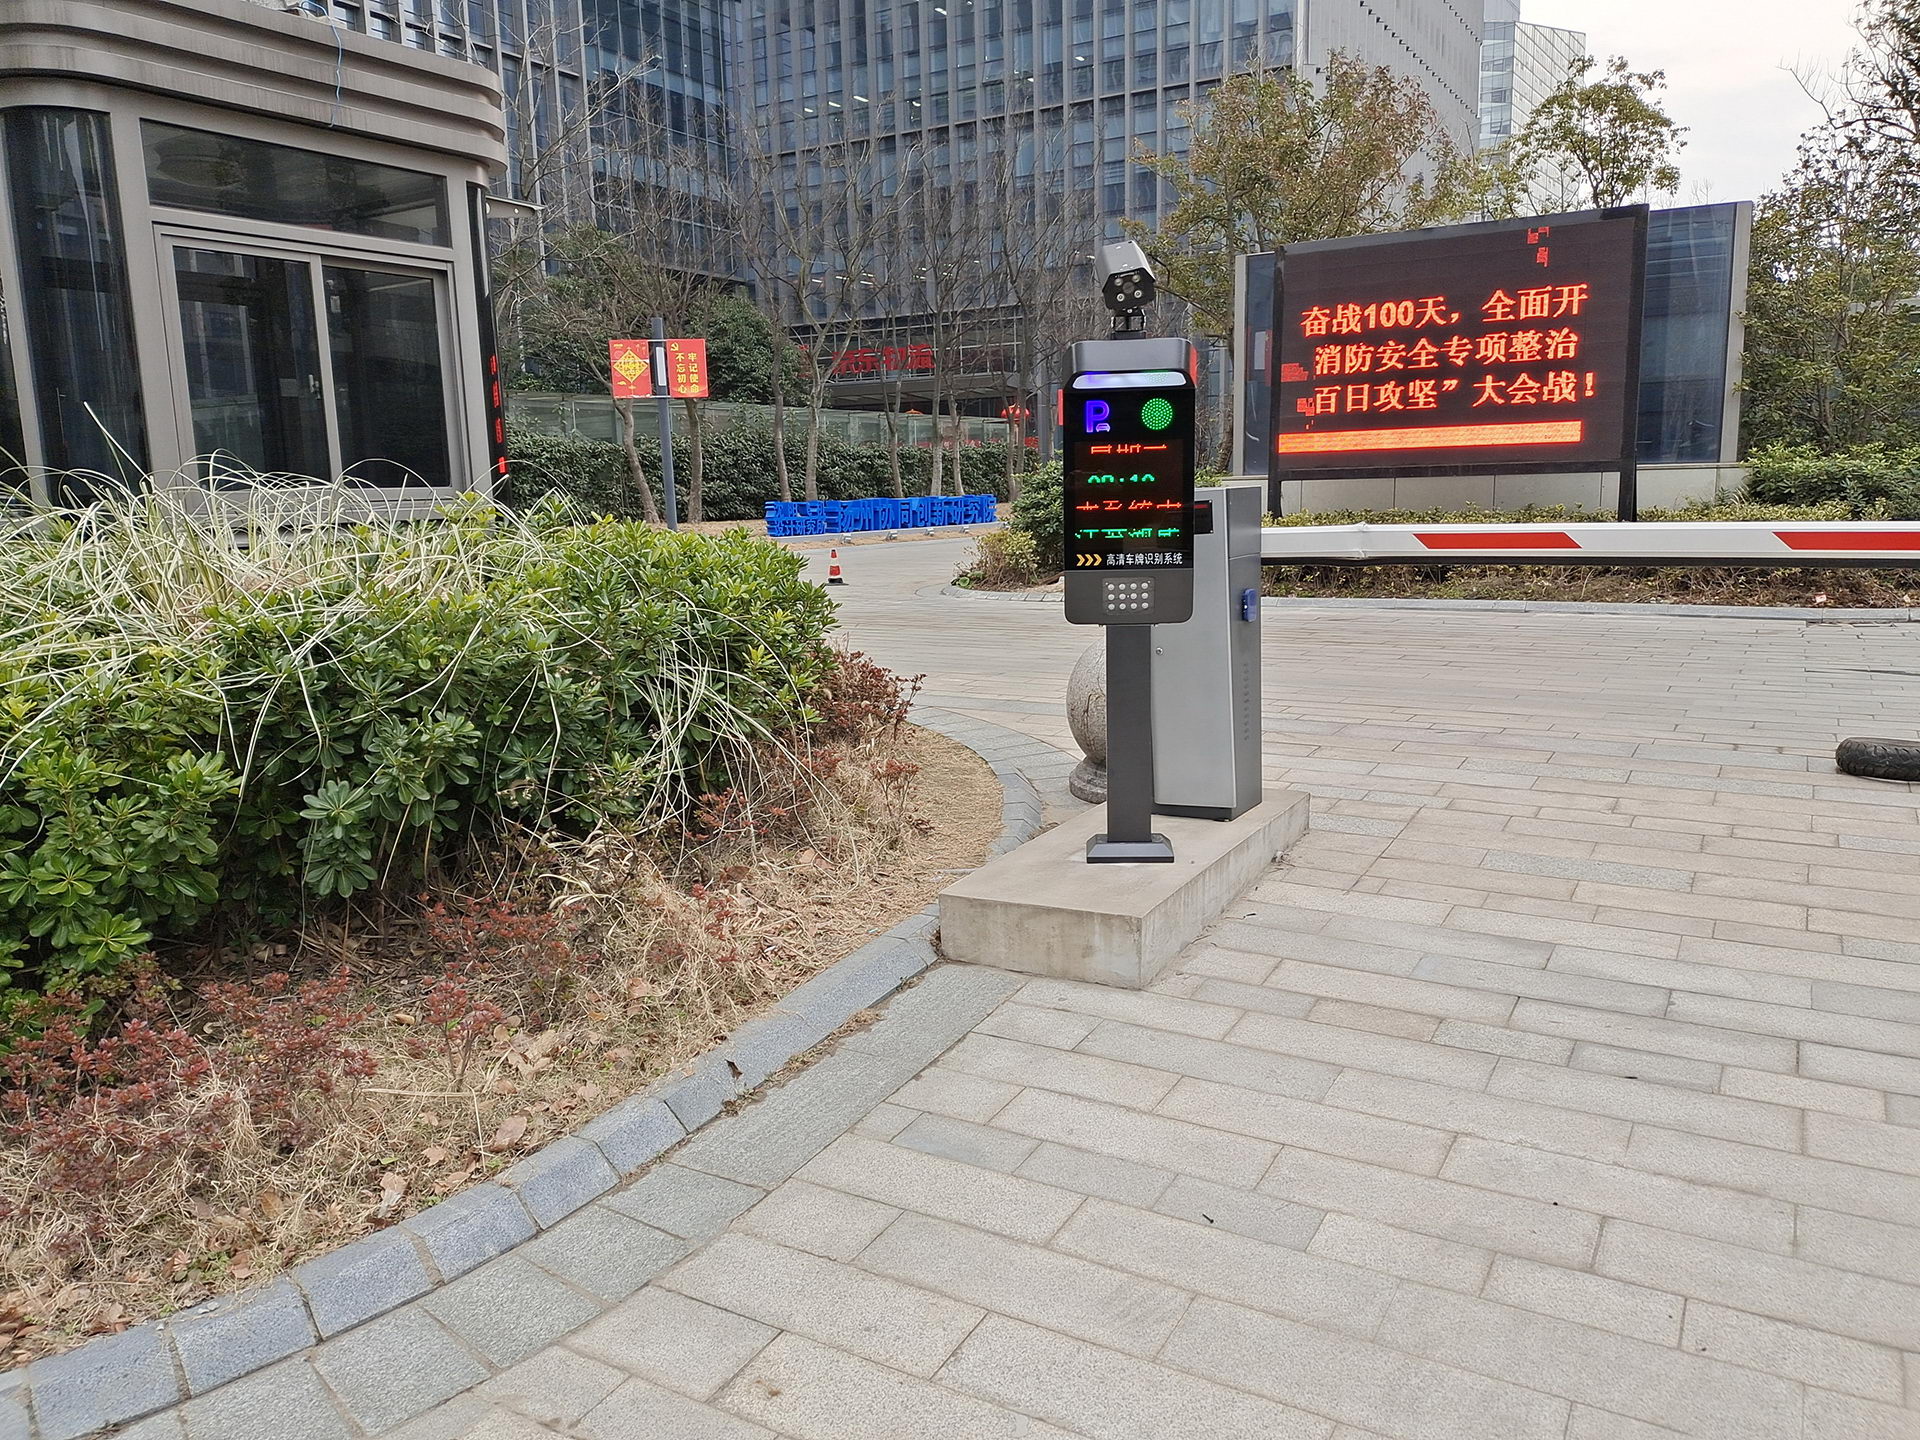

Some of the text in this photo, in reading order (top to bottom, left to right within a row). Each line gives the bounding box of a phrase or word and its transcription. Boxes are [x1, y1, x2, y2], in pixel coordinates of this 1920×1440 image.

[675, 352, 688, 393] 不忘初心
[687, 352, 700, 393] 牢记使命
[1315, 328, 1579, 376] 消防安全专项整治
[1086, 400, 1110, 432] P
[1106, 552, 1183, 567] 高清车牌识别系统
